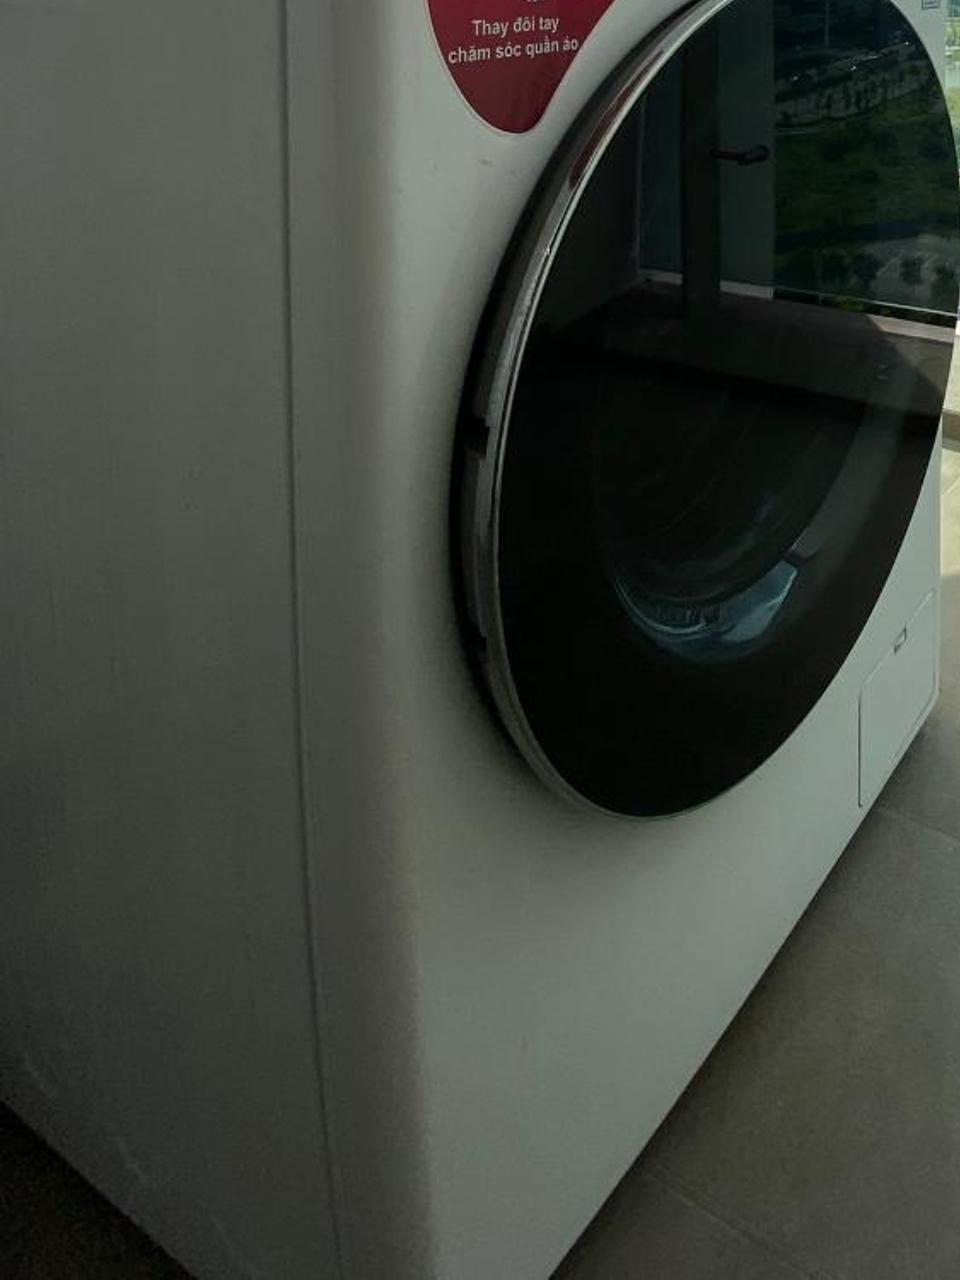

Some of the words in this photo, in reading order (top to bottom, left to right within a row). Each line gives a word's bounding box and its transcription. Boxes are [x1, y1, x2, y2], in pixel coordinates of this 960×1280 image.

[472, 20, 508, 39] Thay
[538, 16, 560, 34] tay
[495, 41, 522, 59] sóc
[562, 37, 579, 51] áo
